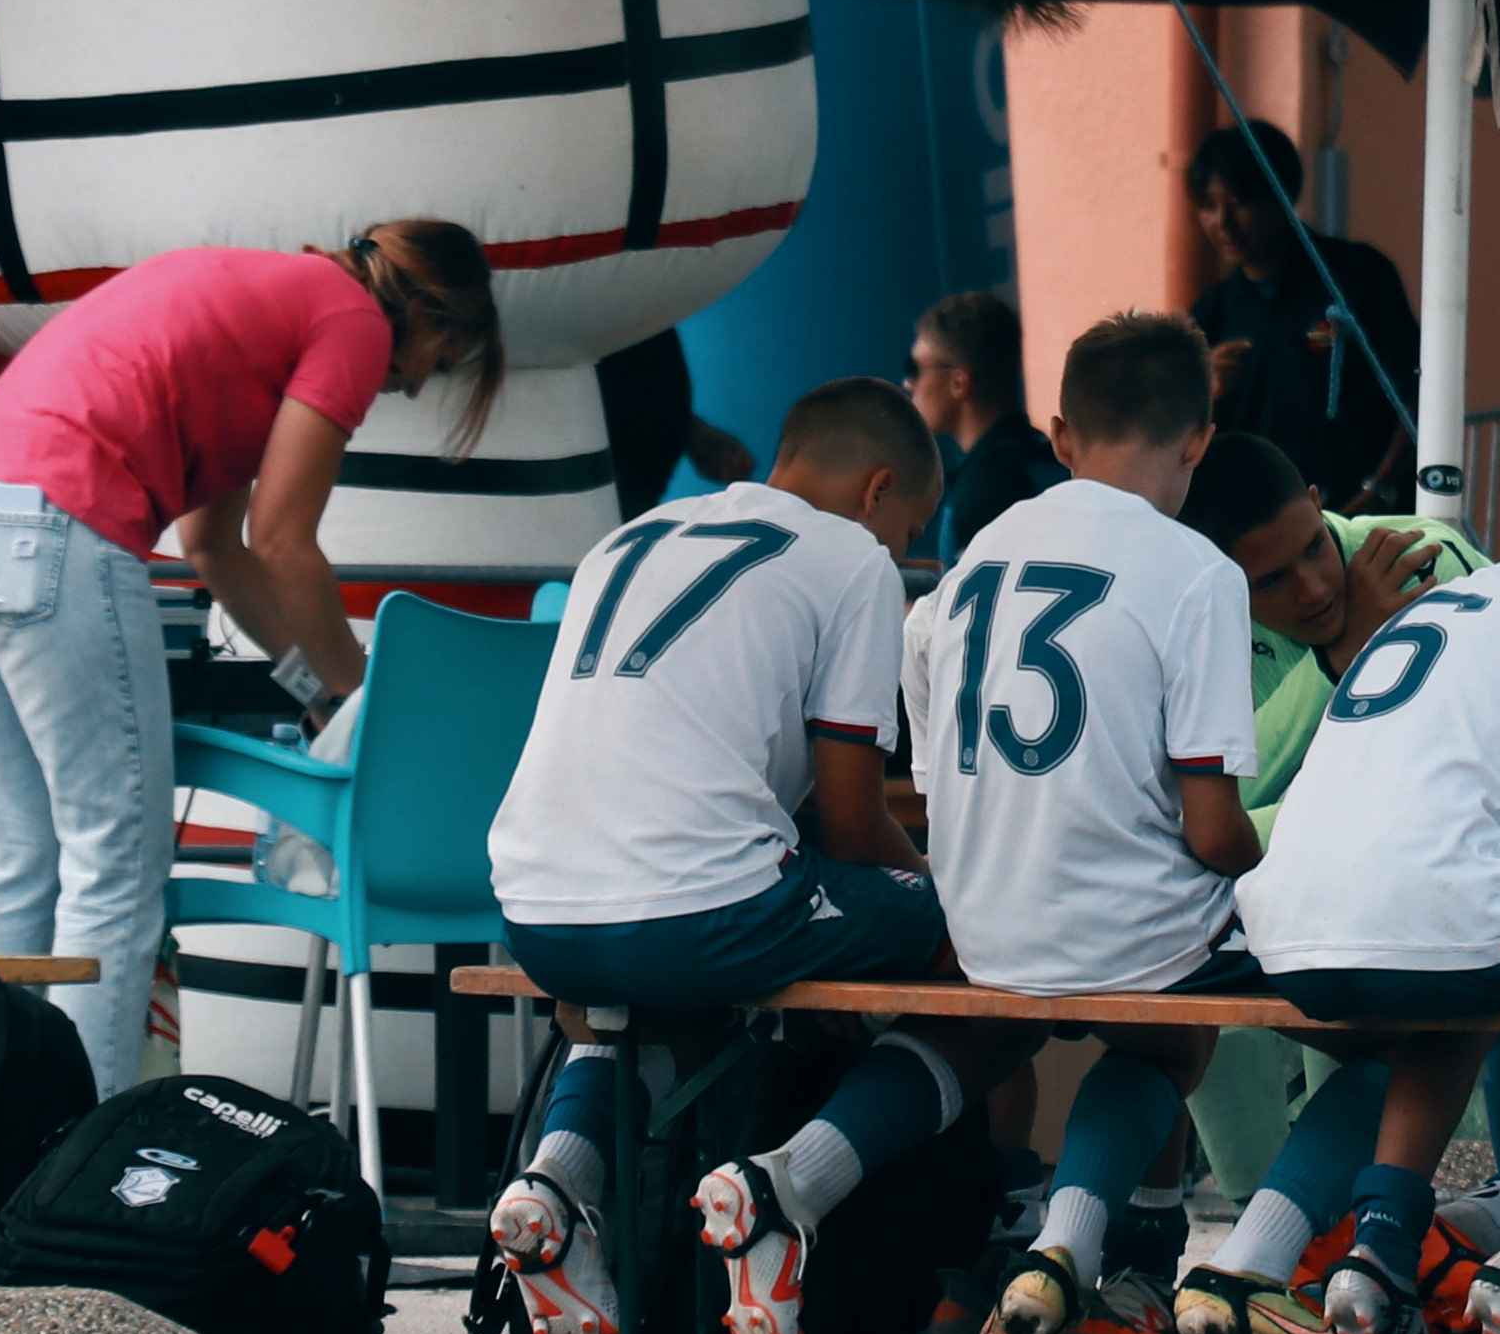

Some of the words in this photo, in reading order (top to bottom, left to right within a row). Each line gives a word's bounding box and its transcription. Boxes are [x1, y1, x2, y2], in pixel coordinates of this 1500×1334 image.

[570, 518, 799, 679] 17
[948, 560, 1116, 776] 13
[1326, 588, 1493, 723] 6
[183, 1086, 283, 1136] capelli
